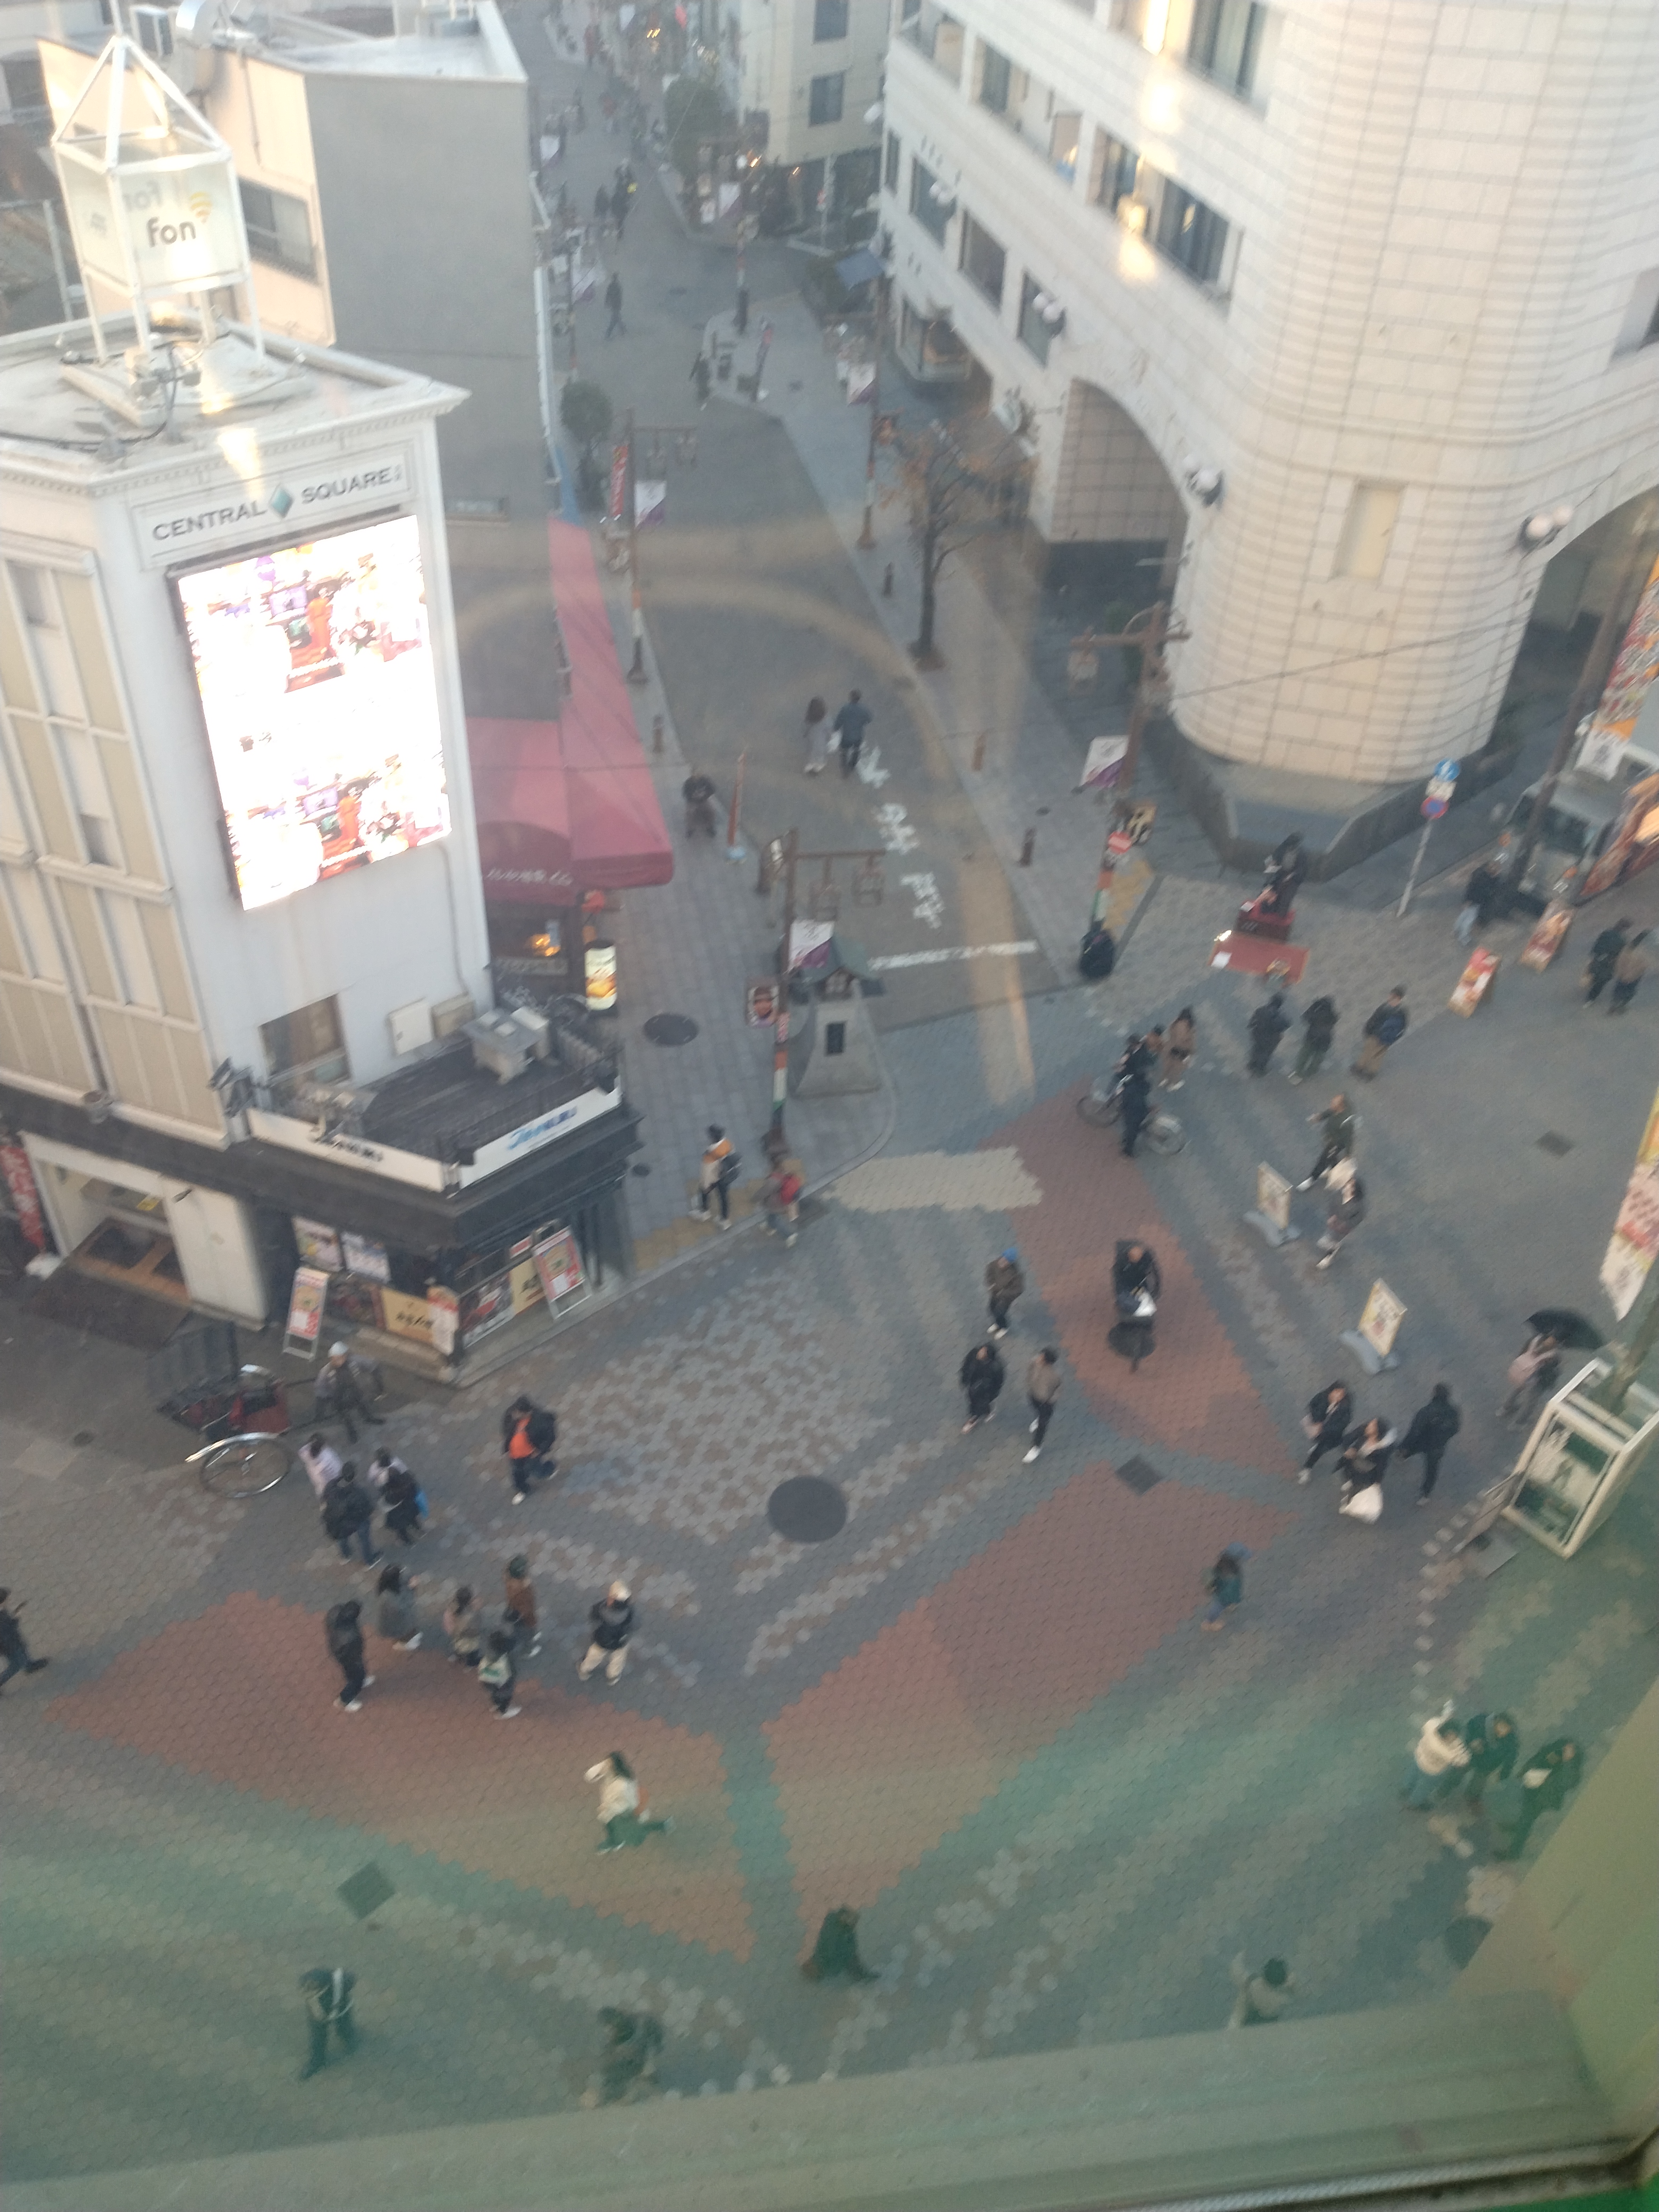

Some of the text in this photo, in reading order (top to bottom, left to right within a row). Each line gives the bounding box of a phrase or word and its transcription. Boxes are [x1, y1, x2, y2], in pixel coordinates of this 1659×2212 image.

[147, 216, 196, 248] fon
[152, 500, 267, 540] CENTRAL
[301, 466, 392, 505] SQUARE
